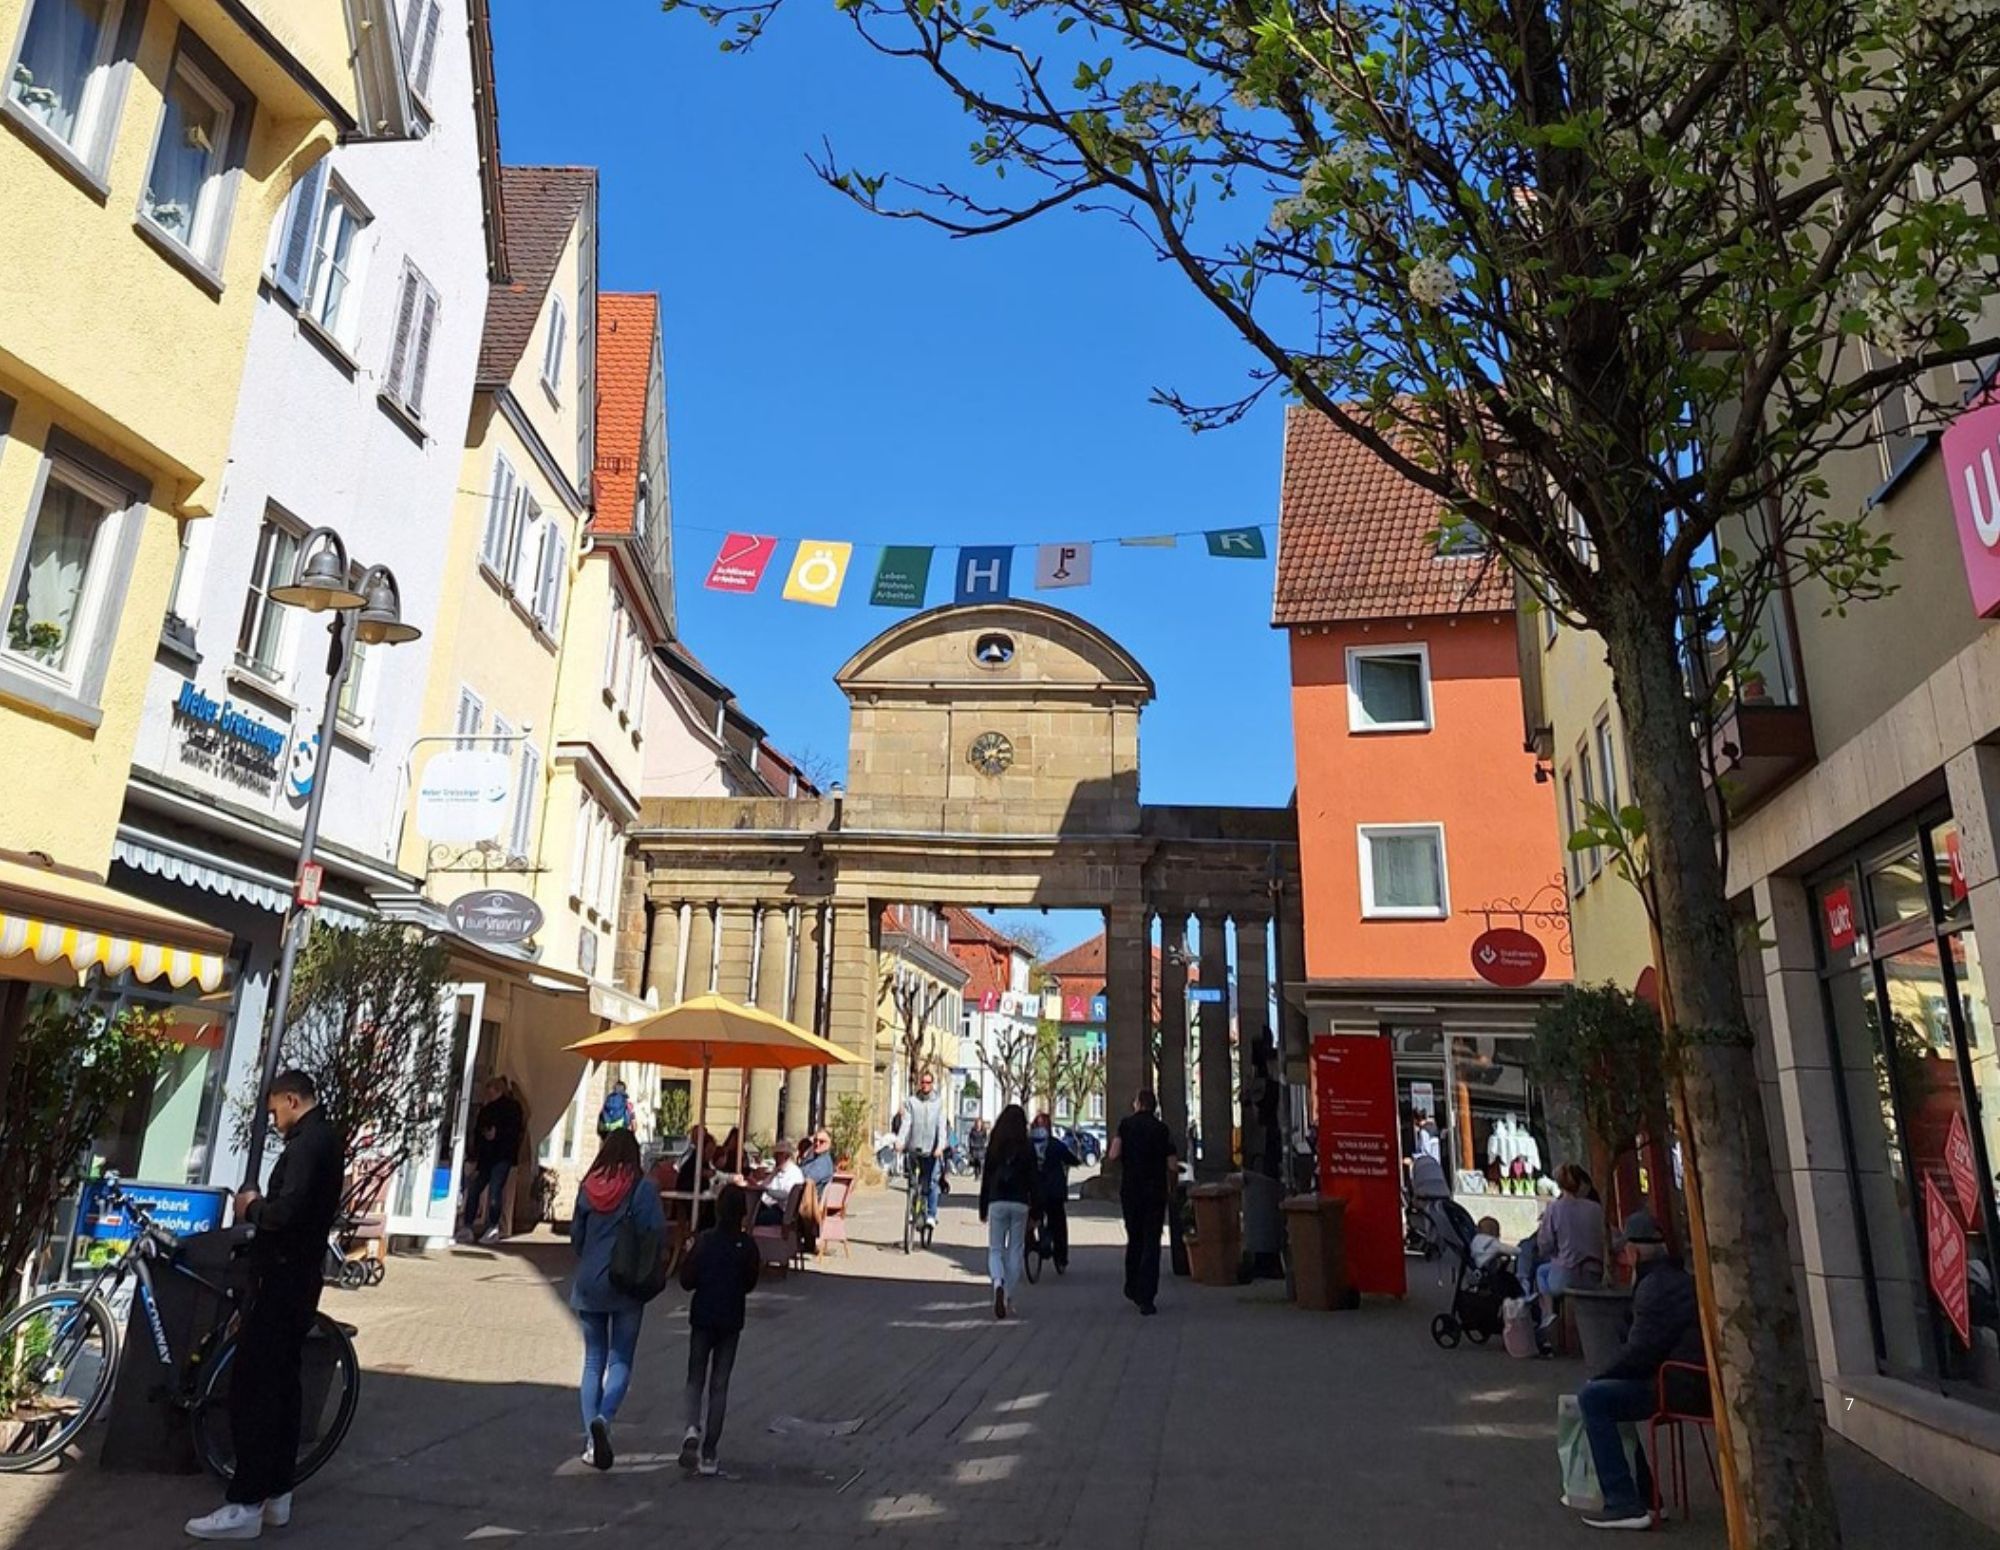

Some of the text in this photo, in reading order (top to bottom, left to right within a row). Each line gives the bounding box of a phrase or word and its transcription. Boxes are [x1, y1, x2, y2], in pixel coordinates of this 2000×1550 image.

[1219, 532, 1254, 550] R
[798, 549, 837, 593] Ö
[966, 559, 1001, 593] H
[1094, 1003, 1105, 1016] R
[146, 1297, 172, 1363] CONWAY
